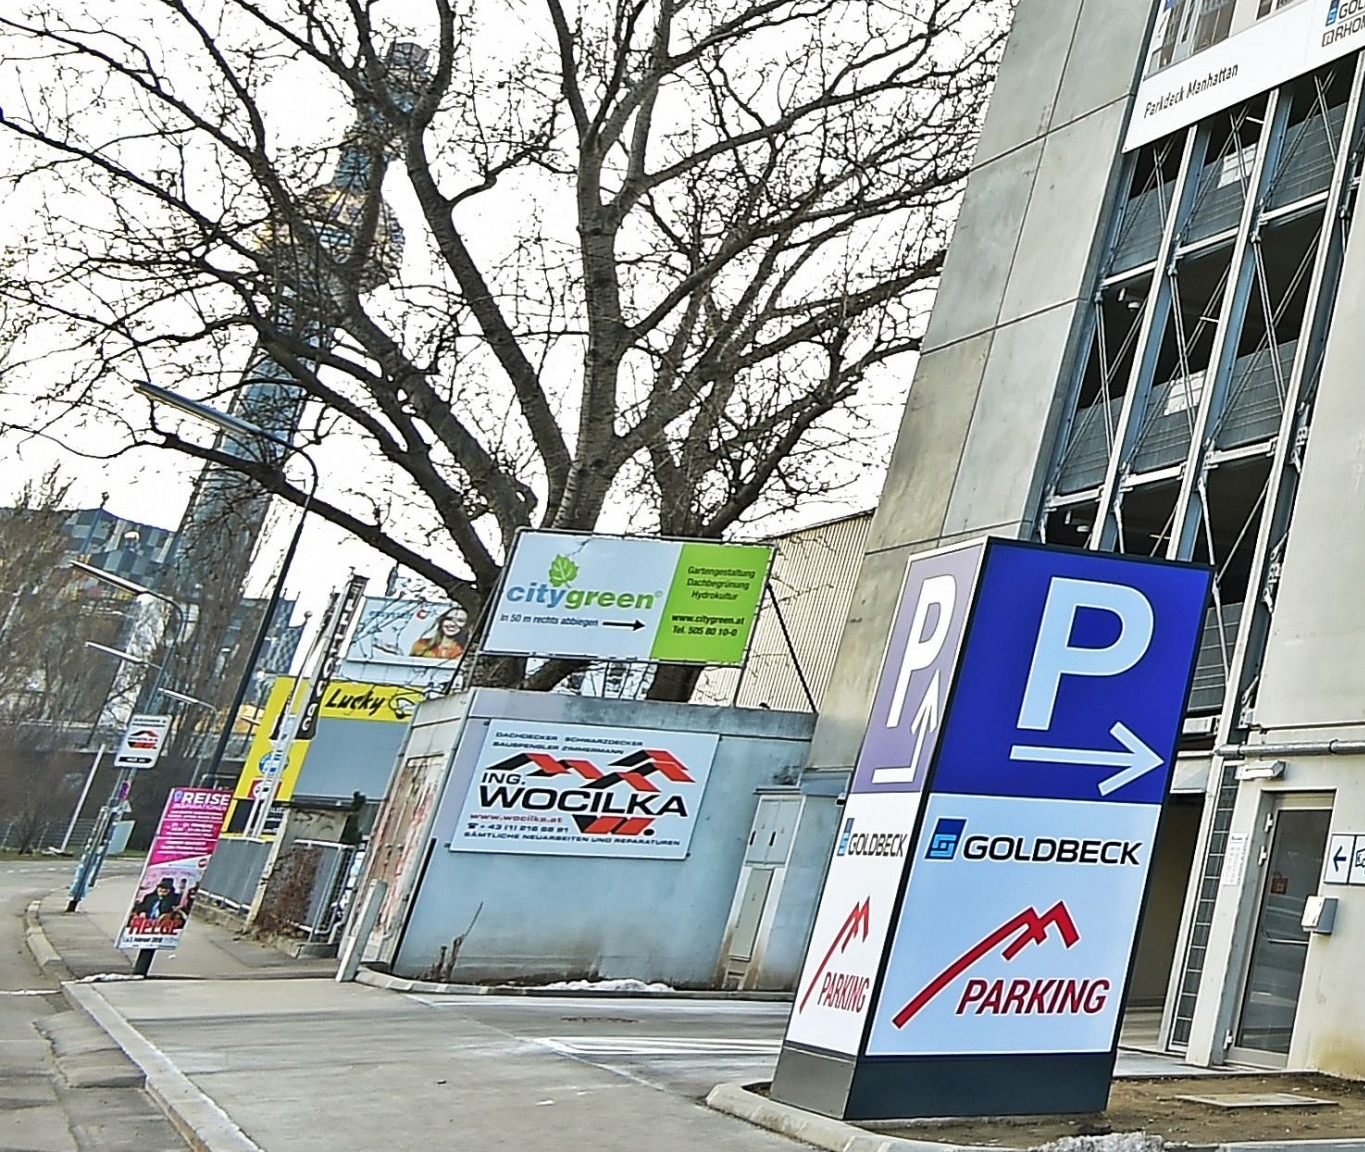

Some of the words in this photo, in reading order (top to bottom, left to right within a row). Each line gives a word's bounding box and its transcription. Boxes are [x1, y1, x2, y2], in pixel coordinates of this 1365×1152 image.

[1144, 86, 1184, 118] Parkdeck
[1187, 63, 1239, 100] Manhattan
[688, 566, 756, 579] Gartengestaltung
[687, 578, 750, 590] Dachbegrünung
[691, 590, 739, 600] Hydrokultur
[510, 614, 521, 622] 50
[533, 616, 558, 624] rechts
[561, 617, 598, 627] abbiegen
[671, 614, 745, 625] www.citygreen.at
[887, 574, 957, 727] P
[1017, 576, 1155, 730] P
[325, 688, 385, 716] Lucky
[496, 732, 558, 741] DACHDECKER
[565, 736, 643, 746] SCHWARZDECKER
[481, 772, 526, 785] ING.
[180, 792, 231, 807] REISE
[479, 785, 688, 817] WOCILKA
[470, 814, 562, 823] www.wocilka.at
[464, 831, 519, 839] SÄMTLICHE
[614, 837, 680, 846] REPARATUREN
[847, 827, 908, 858] GOLDBECK
[963, 835, 1143, 865] GOLDBECK
[818, 971, 870, 1015] PARKING
[956, 978, 1110, 1015] PARKING
